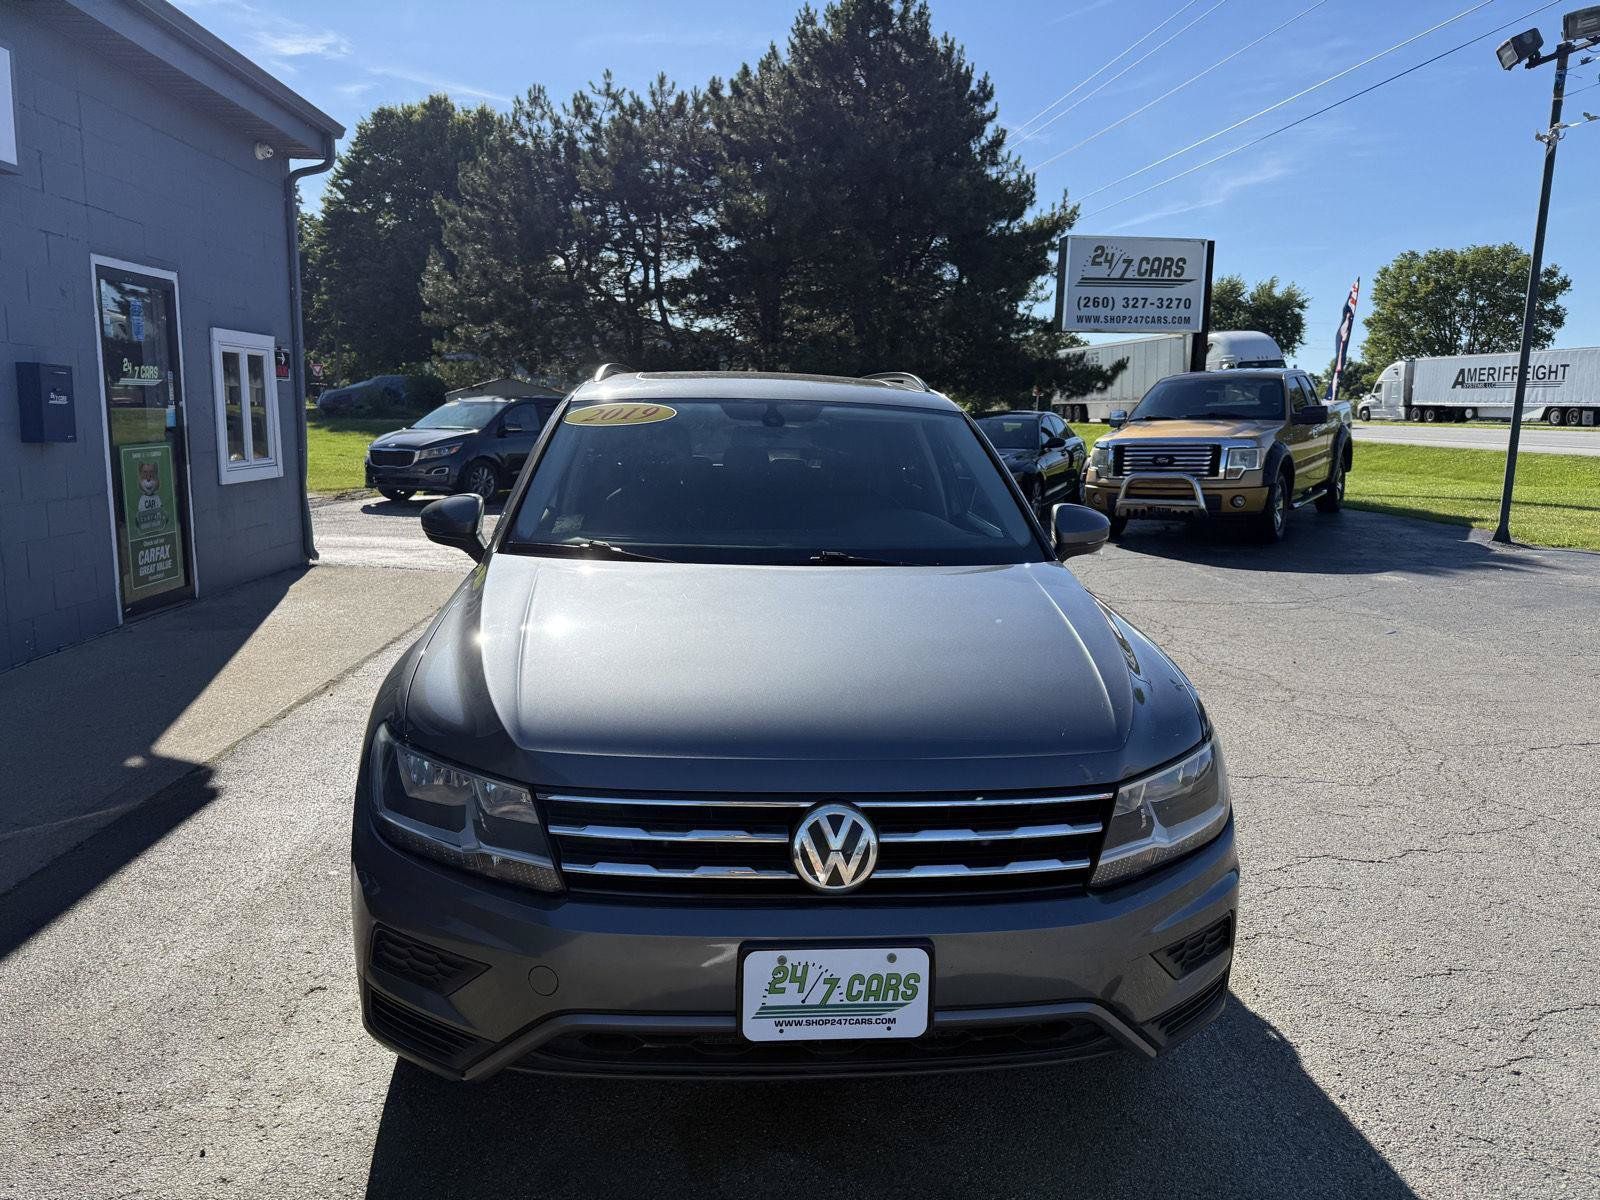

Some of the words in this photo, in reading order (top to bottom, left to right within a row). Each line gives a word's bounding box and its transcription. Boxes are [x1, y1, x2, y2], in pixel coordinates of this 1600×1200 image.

[1136, 256, 1187, 278] CARS
[1077, 296, 1116, 311] (260)
[1122, 297, 1192, 310] 327-3270
[1076, 315, 1191, 325] WWW.SHOP247CARS.COM
[140, 365, 159, 379] CARS
[580, 407, 660, 422] 2019
[138, 544, 171, 566] CARFAX
[139, 564, 156, 577] GREAT
[845, 972, 921, 1002] CARS
[774, 1017, 897, 1028] WWW.SHOP247CARS.COM
